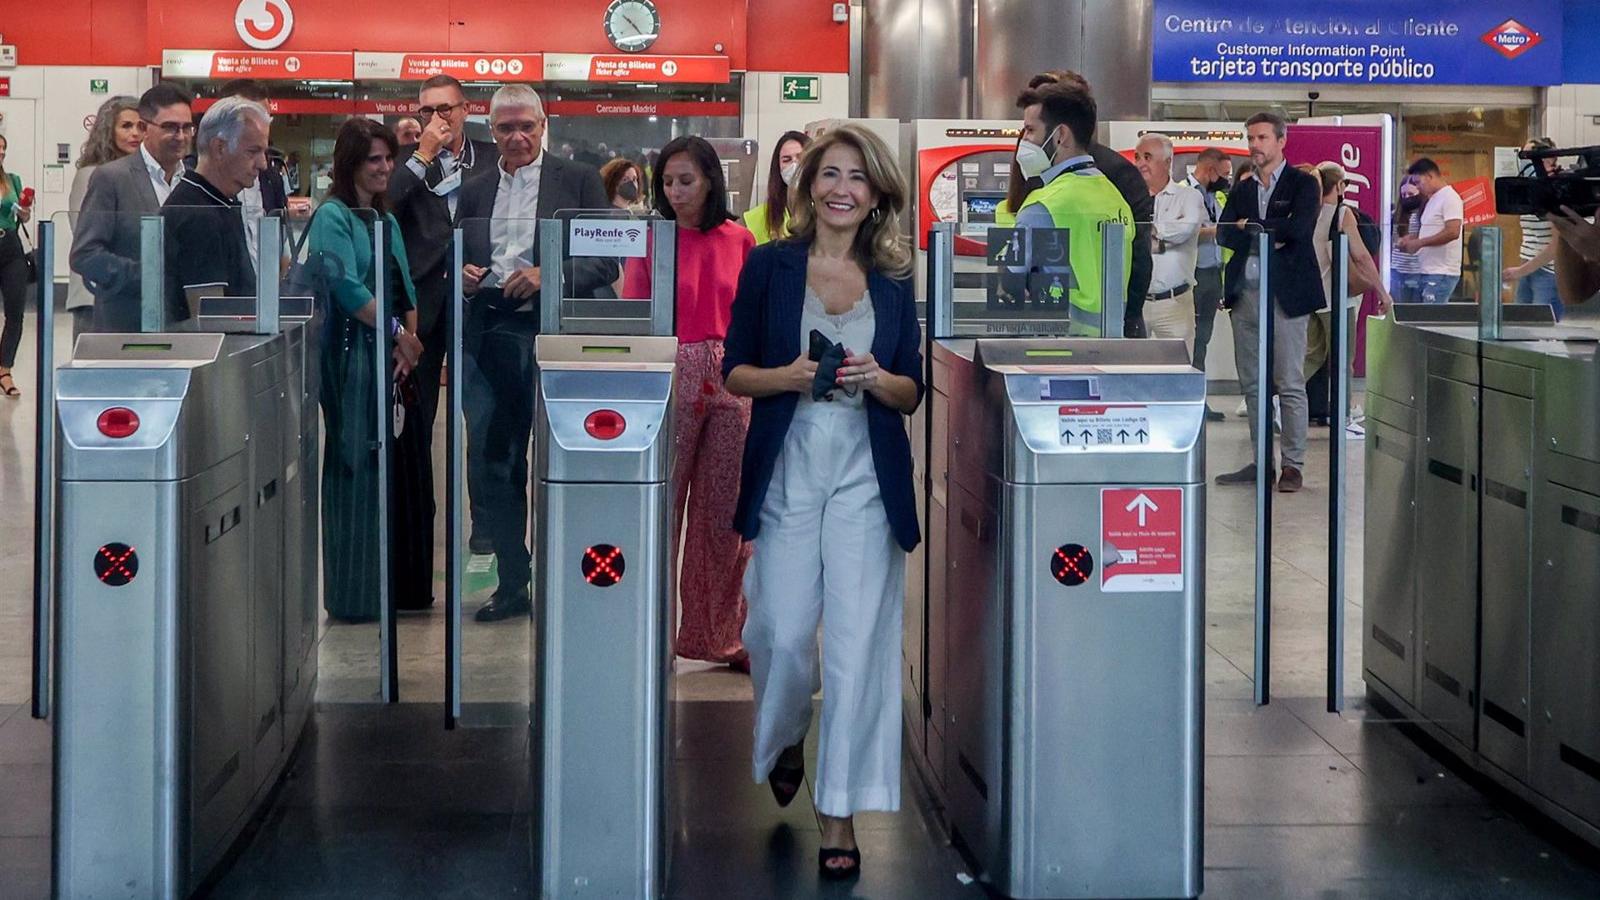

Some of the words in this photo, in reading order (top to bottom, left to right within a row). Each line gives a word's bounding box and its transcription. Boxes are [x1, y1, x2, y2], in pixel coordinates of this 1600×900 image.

[1164, 14, 1233, 34] Centro
[1239, 16, 1265, 34] de
[1273, 16, 1360, 36] tención
[1364, 17, 1380, 36] al
[1497, 34, 1526, 44] Metro
[1216, 42, 1284, 57] Customer
[1288, 43, 1366, 57] Information
[1370, 44, 1406, 58] Point
[216, 56, 239, 66] Venta
[240, 56, 250, 66] de
[251, 56, 279, 66] Billetes
[408, 59, 430, 68] Venta
[430, 59, 440, 68] de
[441, 59, 469, 68] Billetes
[596, 60, 617, 69] Venta
[618, 61, 628, 69] de
[628, 61, 656, 70] Billetes
[1190, 57, 1256, 80] tarjeta
[1261, 59, 1364, 79] transporte
[1368, 59, 1435, 81] público
[375, 103, 396, 113] Venta
[397, 103, 408, 113] de
[469, 103, 487, 112] ffice
[632, 104, 657, 114] Madrid
[574, 227, 624, 239] PlayRenfe
